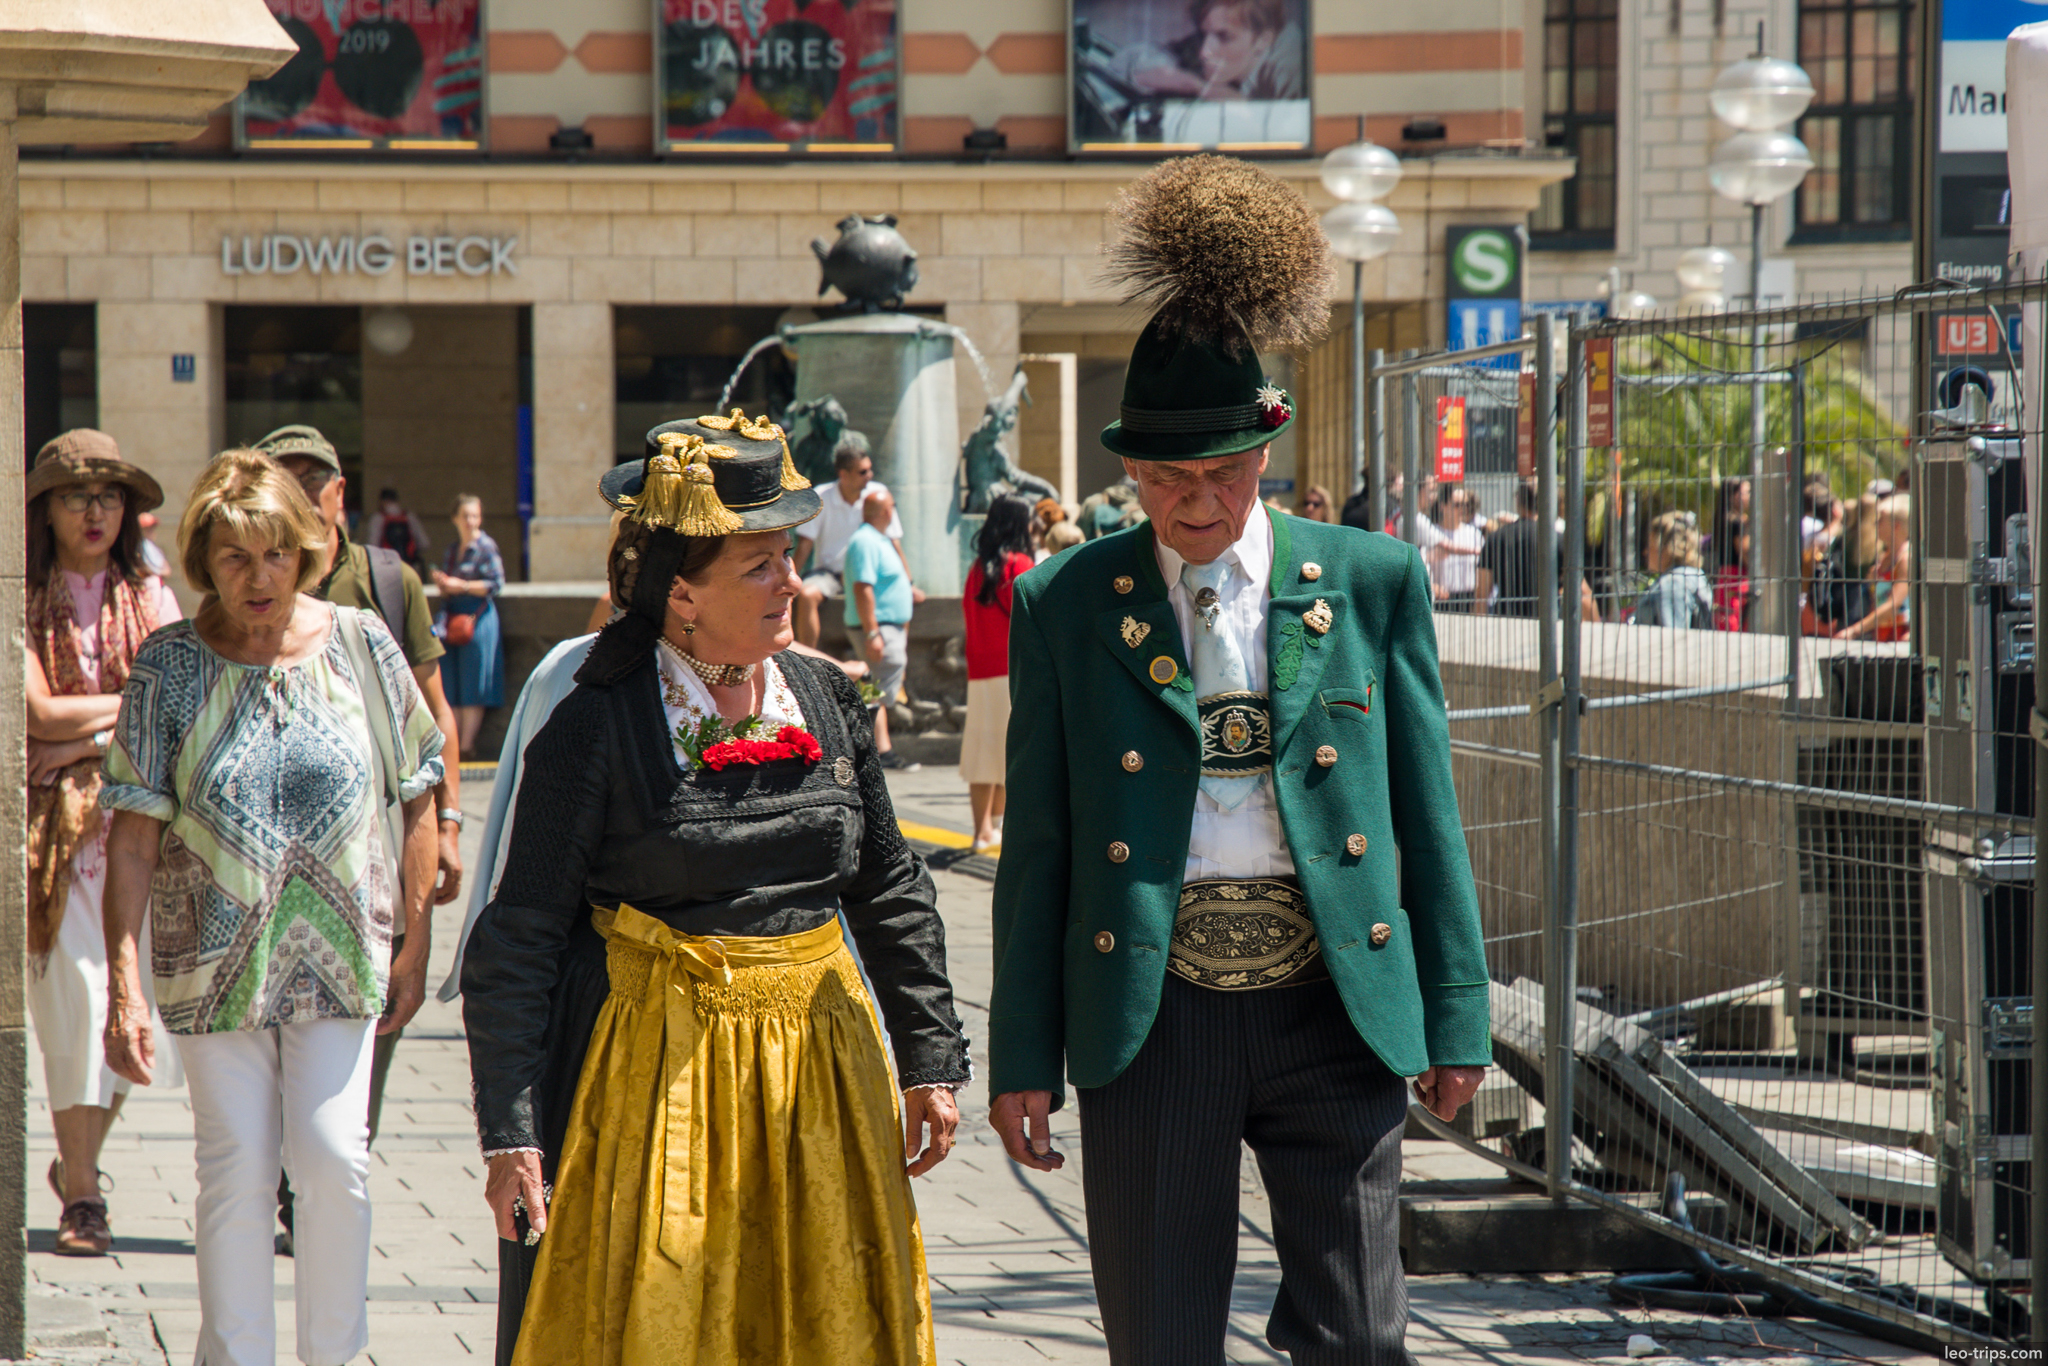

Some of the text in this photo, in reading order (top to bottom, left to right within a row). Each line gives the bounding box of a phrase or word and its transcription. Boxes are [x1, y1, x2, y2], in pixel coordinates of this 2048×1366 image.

[692, 0, 768, 28] DES
[340, 29, 390, 53] 2019
[691, 37, 847, 70] JAHRES
[221, 236, 518, 275] LUDWIG BECK
[1461, 233, 1509, 292] S
[1938, 262, 2002, 283] Eingang
[1950, 321, 1988, 347] U3
